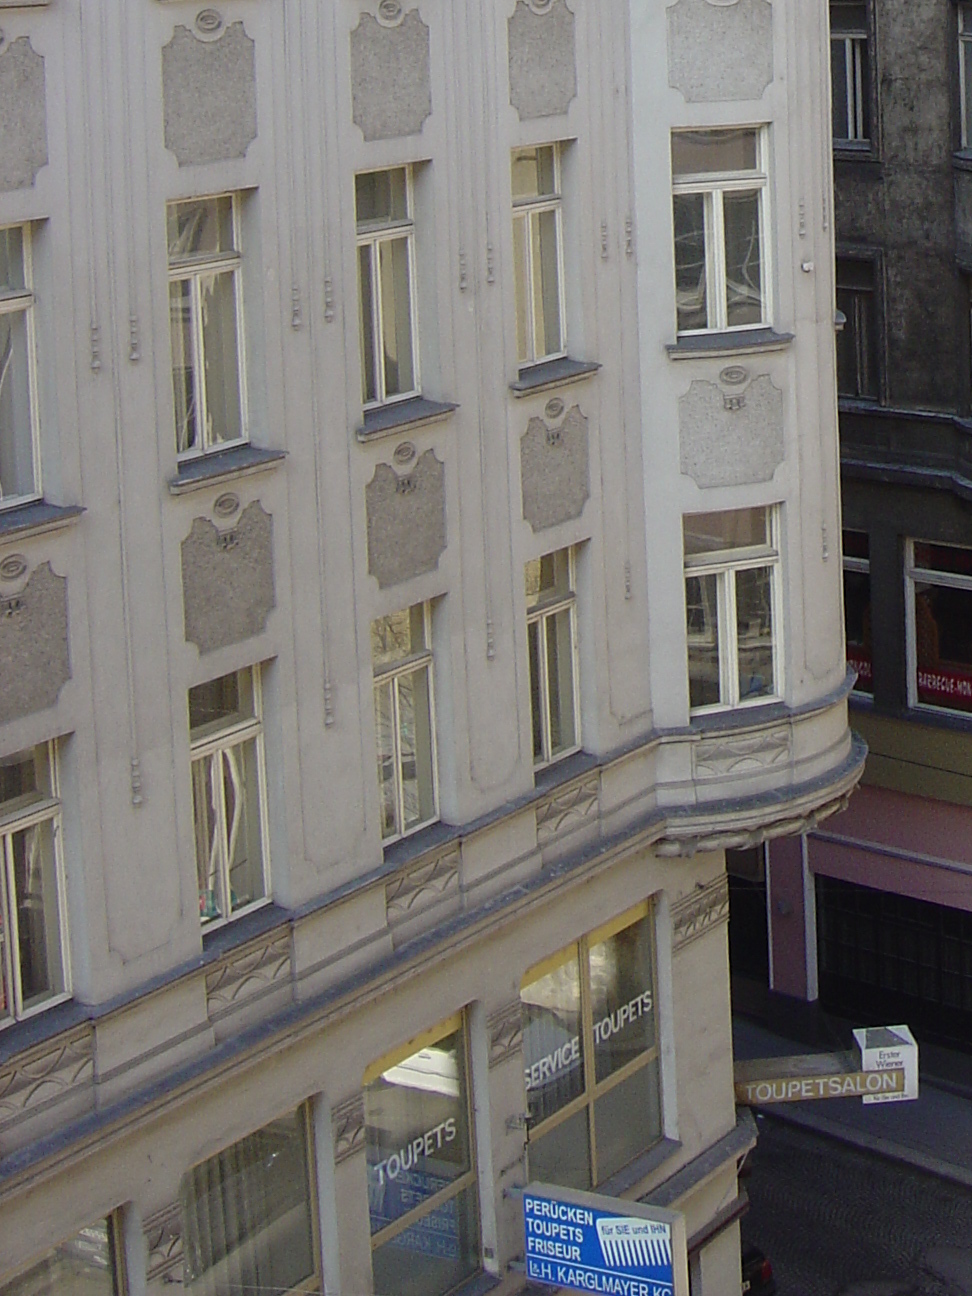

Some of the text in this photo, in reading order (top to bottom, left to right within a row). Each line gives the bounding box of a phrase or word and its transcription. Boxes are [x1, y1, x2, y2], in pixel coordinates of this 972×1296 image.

[593, 990, 653, 1045] TOUPETS
[524, 1036, 580, 1088] SERVICE
[875, 1059, 904, 1069] Wiener
[879, 1050, 900, 1060] Erster
[746, 1073, 897, 1100] TOUPETSALON
[374, 1117, 457, 1185] TOUPETS
[525, 1199, 593, 1226] PERÜCKEN
[526, 1218, 584, 1243] TOUPETS
[601, 1222, 667, 1235] für SIE und IHN
[527, 1237, 581, 1261] FRISEUR
[557, 1266, 649, 1296] KARGLMAYER
